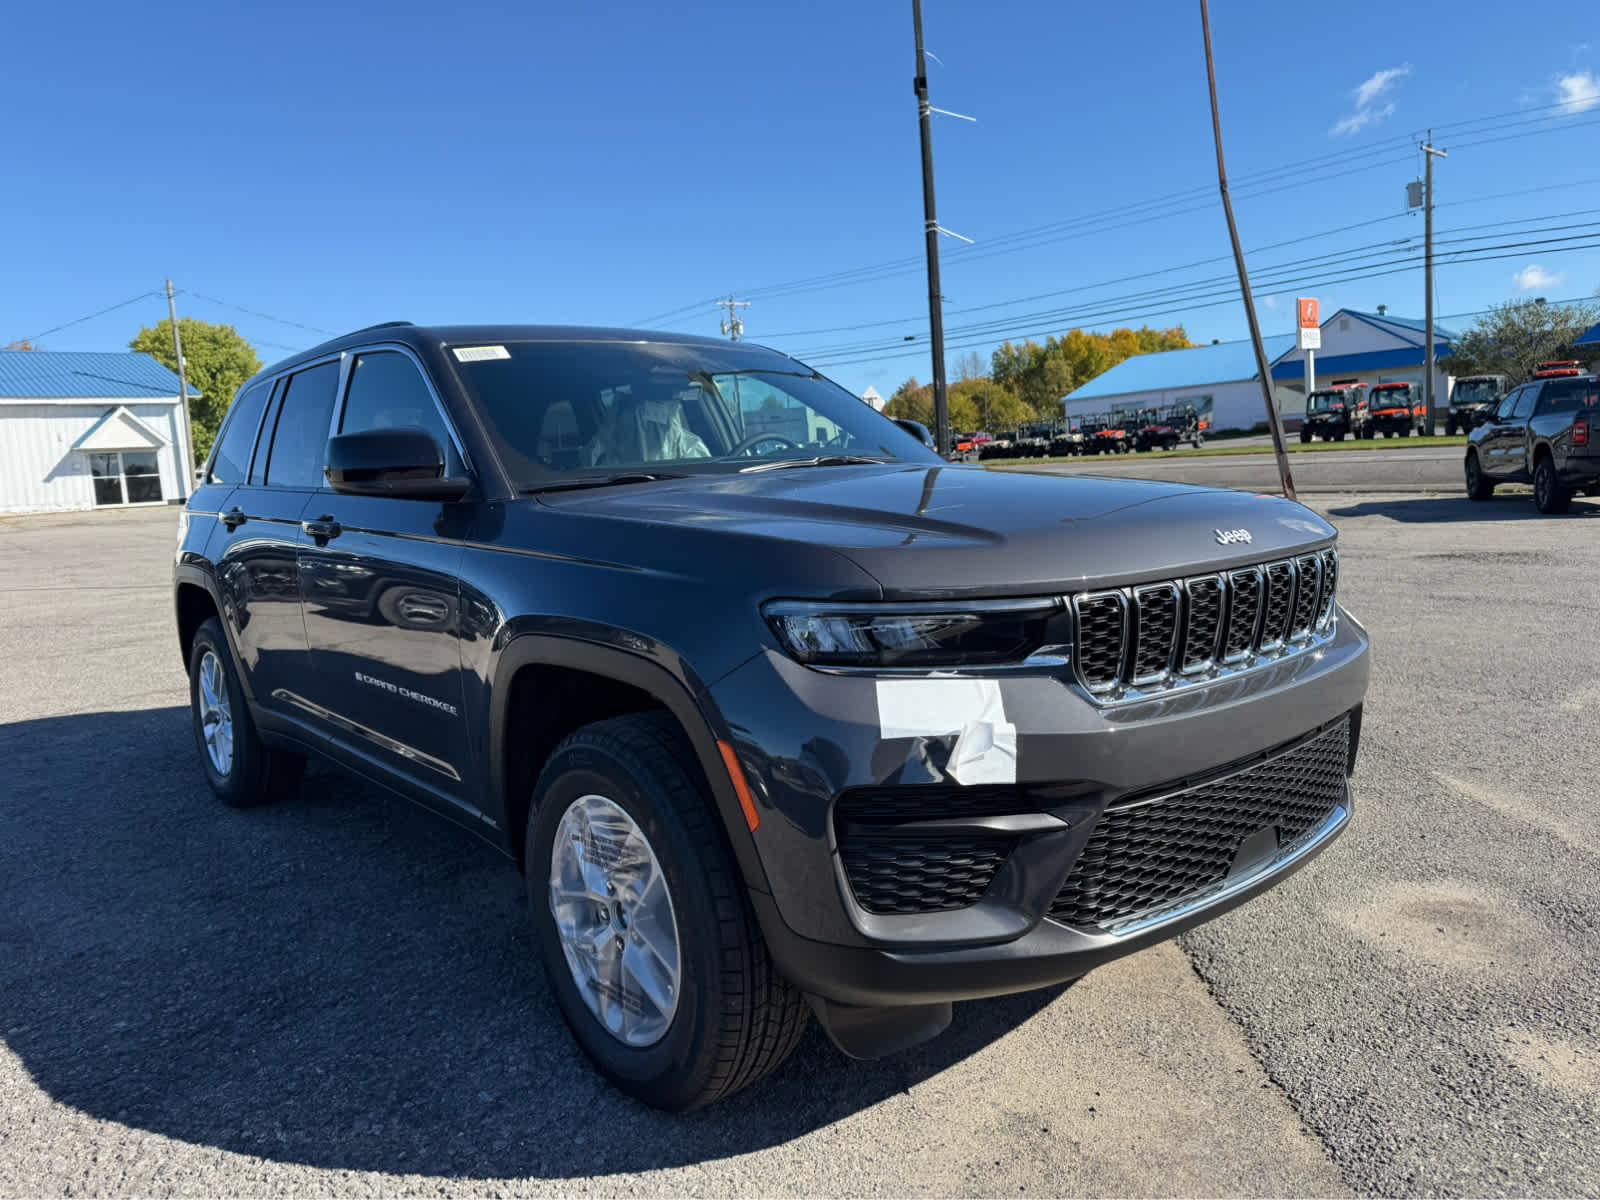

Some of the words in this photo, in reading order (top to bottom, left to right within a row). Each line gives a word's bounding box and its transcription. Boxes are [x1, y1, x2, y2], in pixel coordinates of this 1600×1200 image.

[1215, 528, 1253, 545] Jeep
[362, 675, 398, 693] GRAND
[398, 687, 458, 716] CHEROKEE
